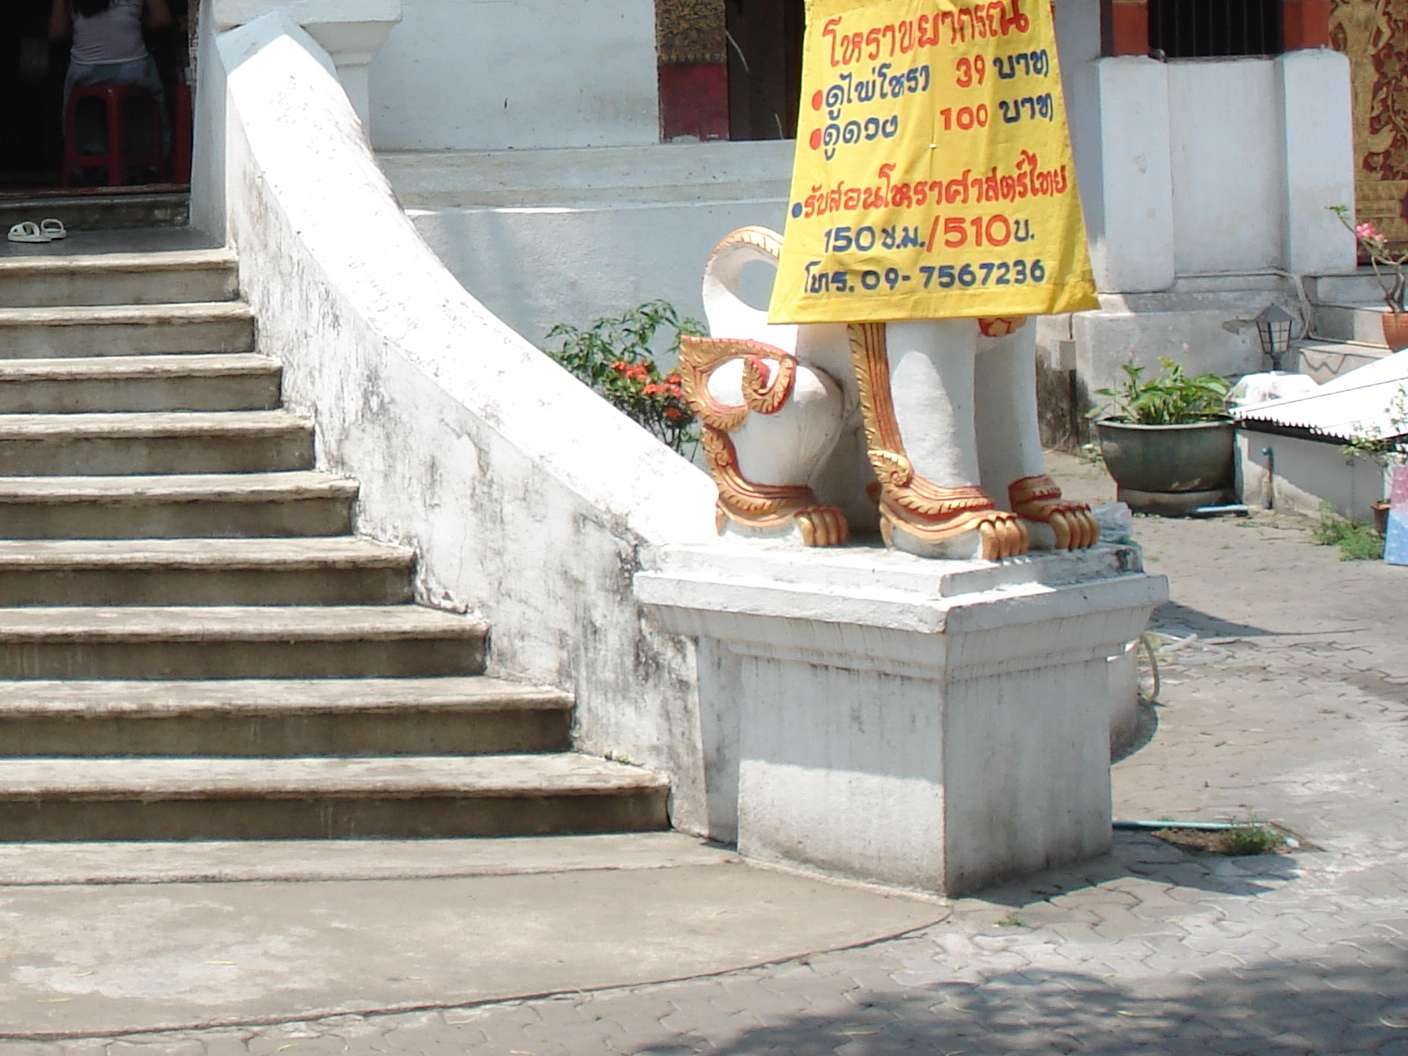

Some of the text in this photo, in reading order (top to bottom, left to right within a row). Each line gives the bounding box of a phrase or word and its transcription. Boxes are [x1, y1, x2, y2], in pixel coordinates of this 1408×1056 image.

[825, 49, 1049, 121] ดูไพ่โหรา 39 บาท
[823, 92, 1054, 161] ดูดวง 100 บาท
[804, 149, 1068, 219] รับสอนโหราศาสตร์ไทย
